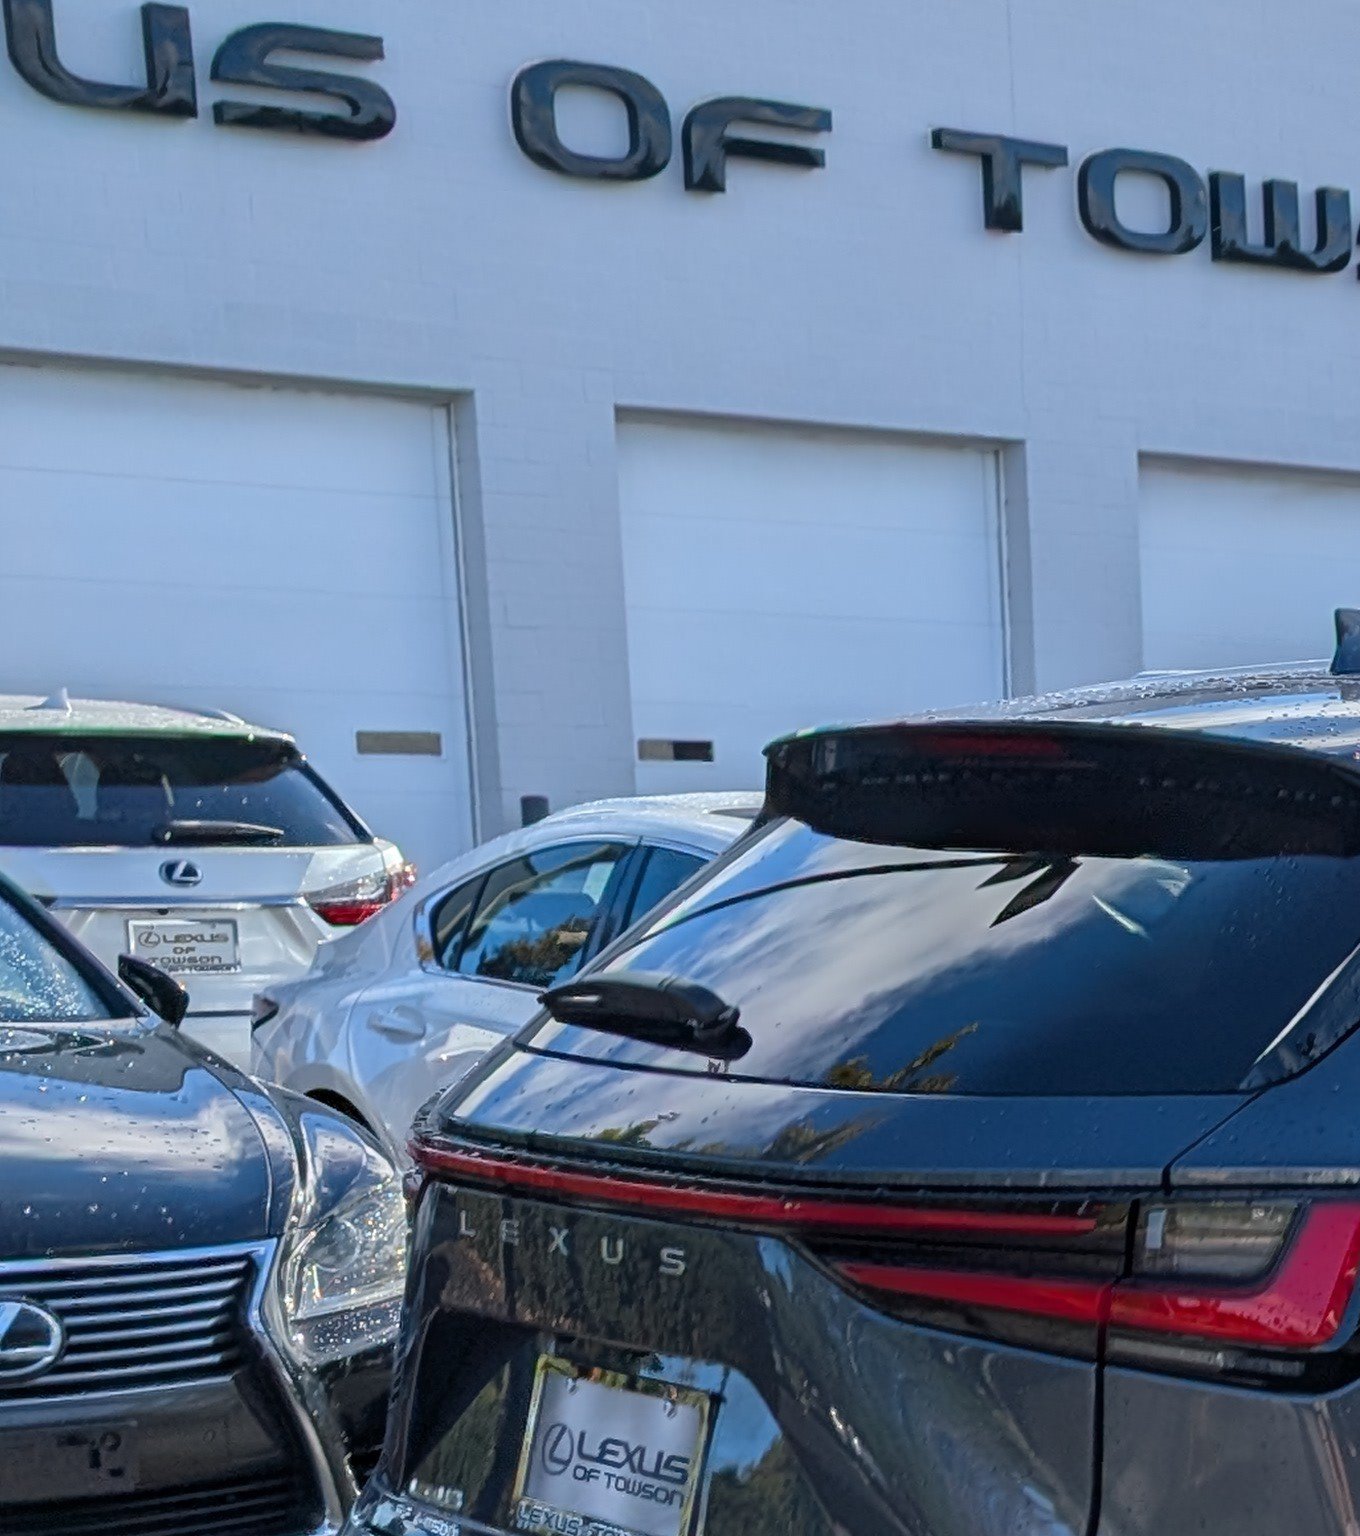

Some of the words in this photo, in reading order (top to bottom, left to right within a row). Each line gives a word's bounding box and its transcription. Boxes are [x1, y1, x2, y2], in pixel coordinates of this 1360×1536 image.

[509, 58, 832, 192] OF
[163, 933, 229, 944] LEXUS
[172, 946, 196, 955] OF
[459, 1209, 686, 1277] LEXUS
[577, 1430, 691, 1486] LEXUS
[572, 1464, 600, 1483] OF
[603, 1472, 685, 1509] TOWSON
[517, 1503, 581, 1536] LEXUS
